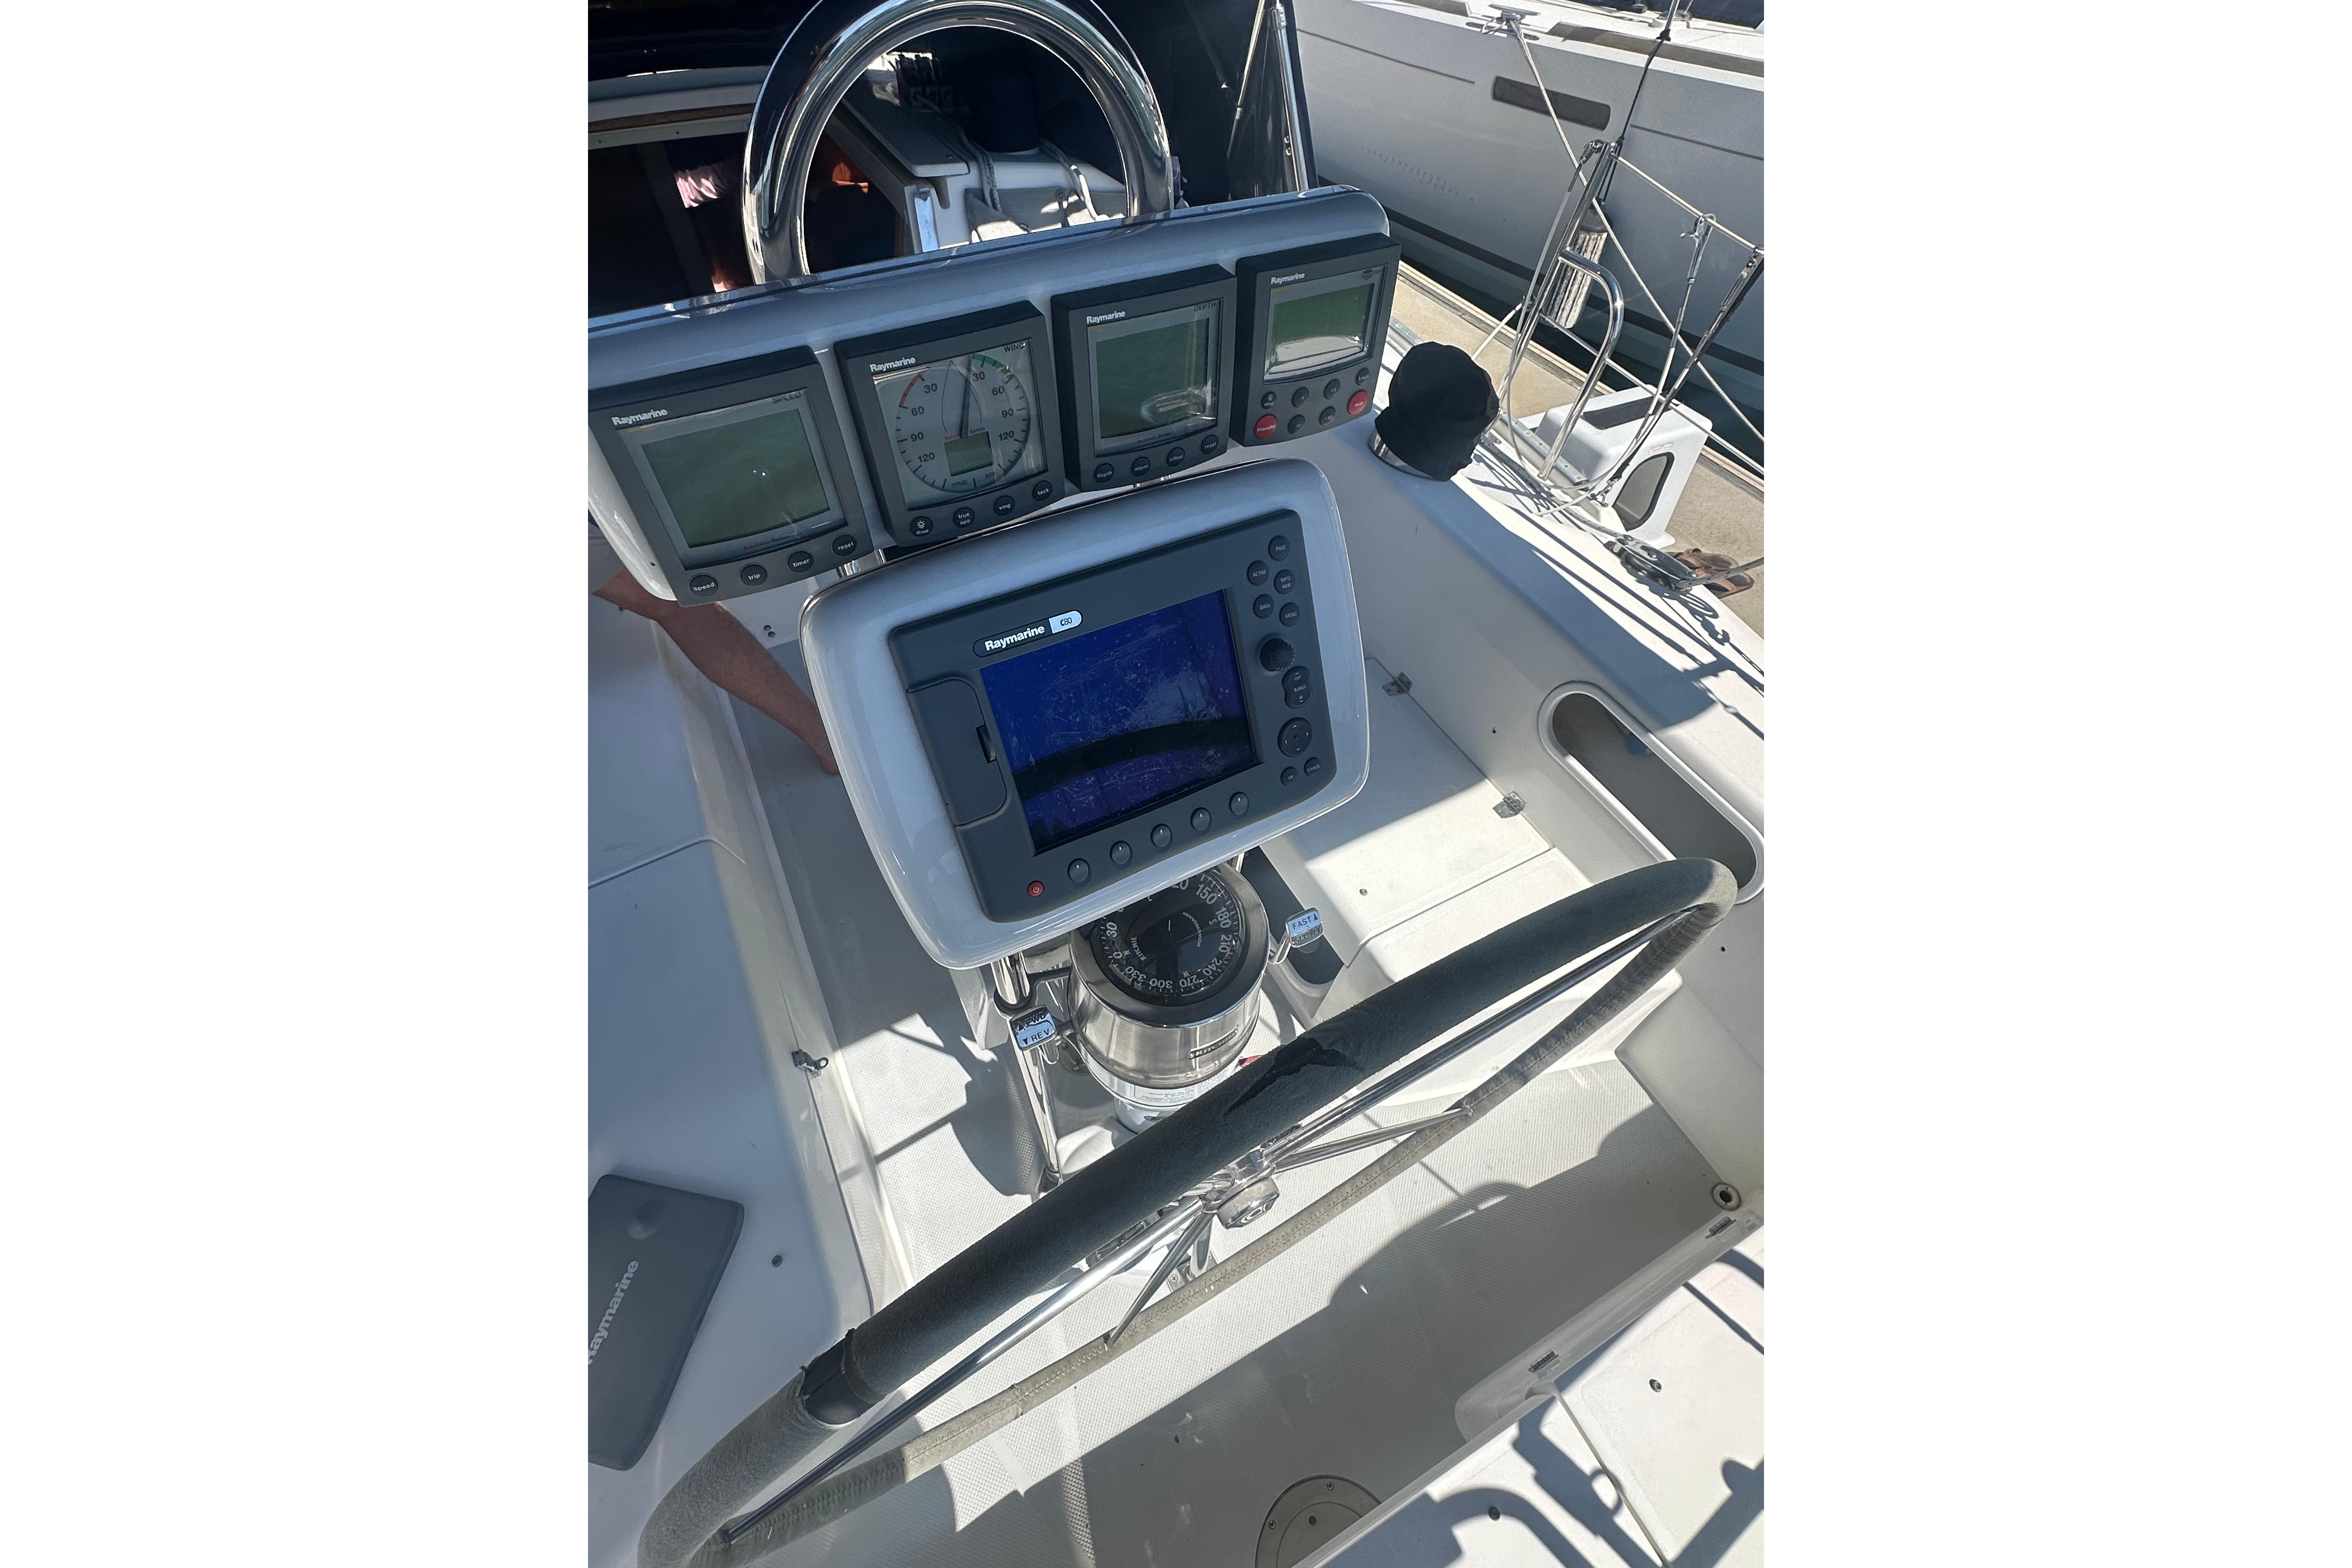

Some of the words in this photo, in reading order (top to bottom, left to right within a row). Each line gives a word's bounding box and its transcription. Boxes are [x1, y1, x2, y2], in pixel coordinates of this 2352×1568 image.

[1271, 272, 1306, 285] Raymarine
[1194, 301, 1216, 311] DEPTH
[1086, 311, 1125, 324] Raymarine
[1004, 342, 1026, 352] WIND
[870, 357, 916, 372] Raymarine
[972, 371, 985, 381] 30
[924, 383, 938, 394] 30
[992, 386, 1005, 396] 60
[772, 391, 802, 404] SPEED
[612, 408, 668, 425] Raymarine
[912, 406, 924, 416] 60
[1001, 408, 1014, 418] 90
[910, 432, 924, 441] 90
[998, 431, 1015, 441] 120
[918, 452, 935, 463] 120
[951, 479, 968, 488] TRUE
[838, 542, 854, 551] reset
[793, 558, 810, 567] timer
[693, 582, 715, 592] speed
[984, 625, 1045, 651] Raymarine
[1060, 617, 1072, 626] C80
[1196, 884, 1217, 905] 150
[1215, 907, 1231, 929] 180
[1292, 916, 1311, 930] FAST
[1106, 922, 1117, 938] 30
[1183, 912, 1203, 947] POWERDAMP
[1131, 936, 1146, 962] RITCHIE
[1218, 934, 1232, 953] 210
[1203, 958, 1222, 976] 240
[1125, 966, 1146, 982] 330
[1150, 978, 1172, 989] 300
[1179, 975, 1199, 988] 270
[1031, 1029, 1049, 1042] REV
